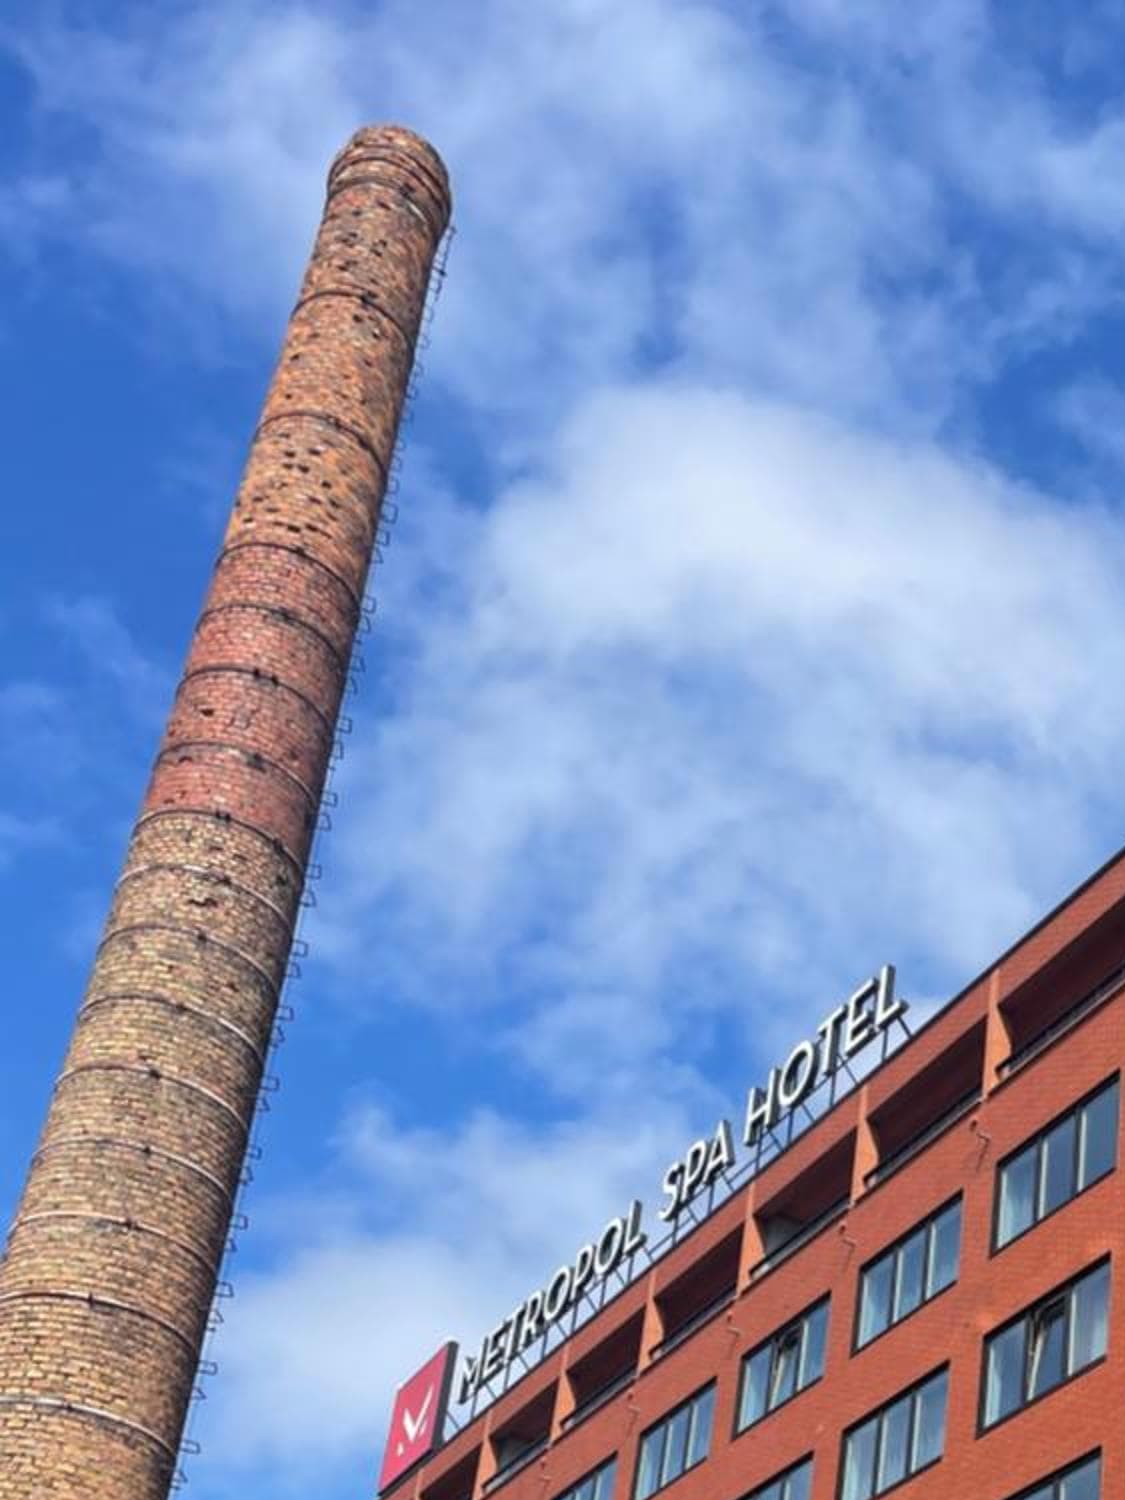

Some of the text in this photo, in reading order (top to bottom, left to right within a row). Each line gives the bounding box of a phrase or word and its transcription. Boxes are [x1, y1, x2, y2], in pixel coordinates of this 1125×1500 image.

[458, 963, 909, 1405] METROPOL SPA HOTEL
